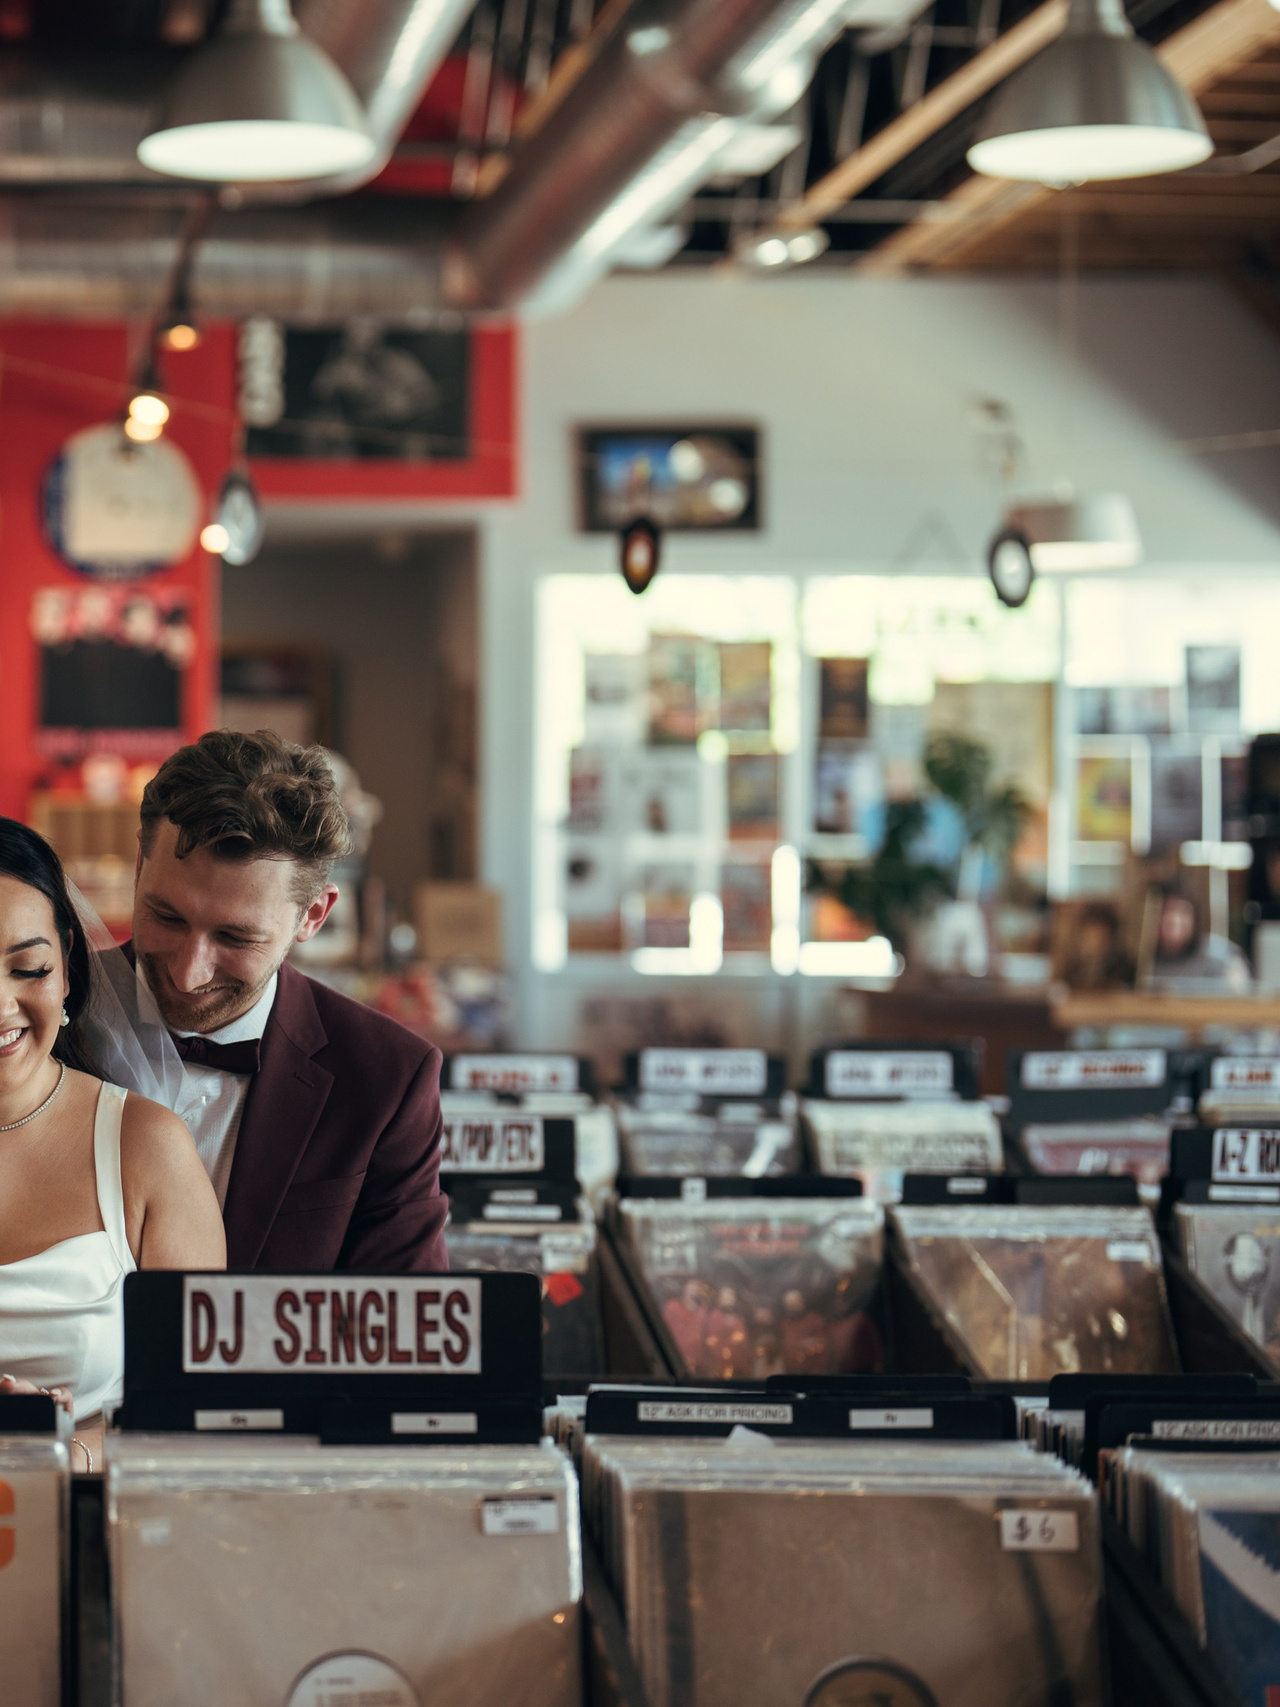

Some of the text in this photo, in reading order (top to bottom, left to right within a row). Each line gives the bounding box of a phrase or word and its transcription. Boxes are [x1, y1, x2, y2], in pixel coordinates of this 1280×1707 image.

[1219, 1132, 1249, 1173] A-Z
[190, 1290, 472, 1365] DJ SINGLES
[643, 1405, 789, 1420] 12" ASK FOR PRICING
[1183, 1423, 1209, 1436] ASK
[1213, 1424, 1243, 1436] FOR
